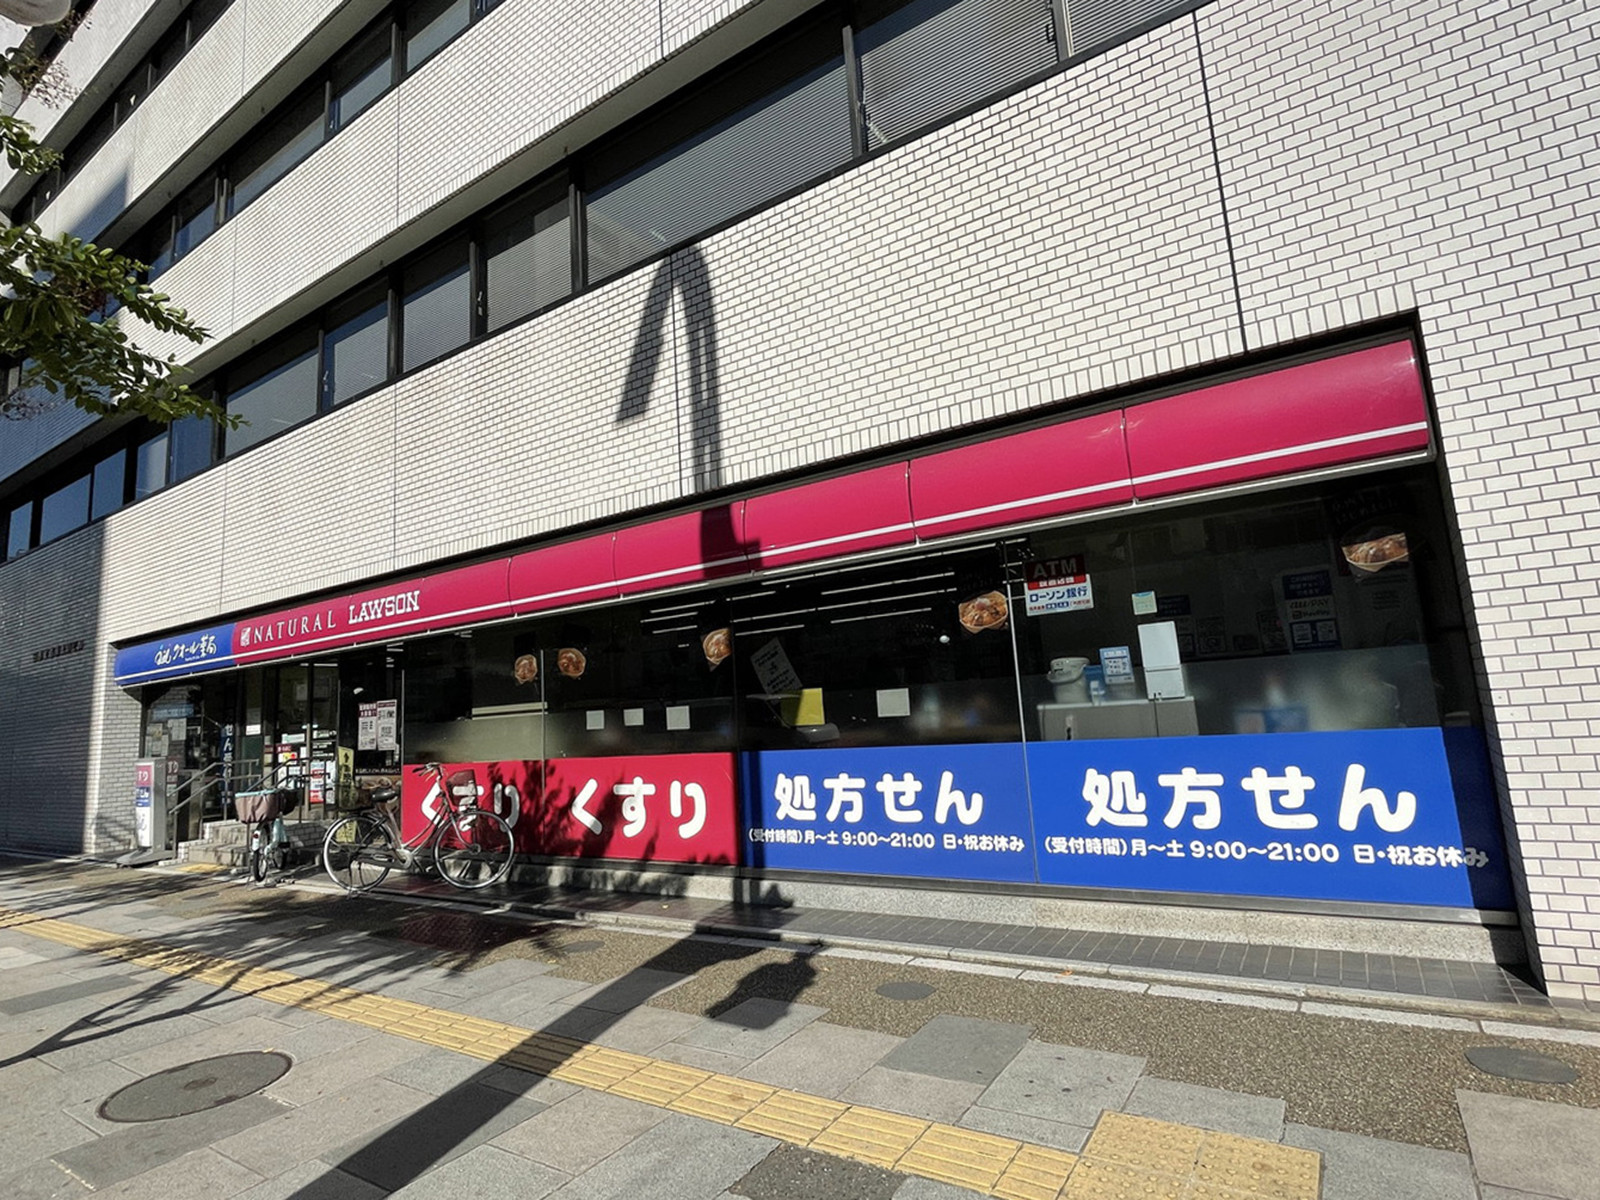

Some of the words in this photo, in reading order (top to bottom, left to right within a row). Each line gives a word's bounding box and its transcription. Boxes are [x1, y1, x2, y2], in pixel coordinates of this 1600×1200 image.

[1030, 585, 1088, 603] ローソン銀行
[1032, 557, 1078, 580] ATM
[254, 610, 337, 644] NATURAL
[348, 590, 421, 625] LAWSON
[172, 634, 218, 660] クオール薬局
[571, 776, 707, 839] くすり
[774, 770, 984, 826] 処方せん
[1082, 763, 1417, 833] 処方せん
